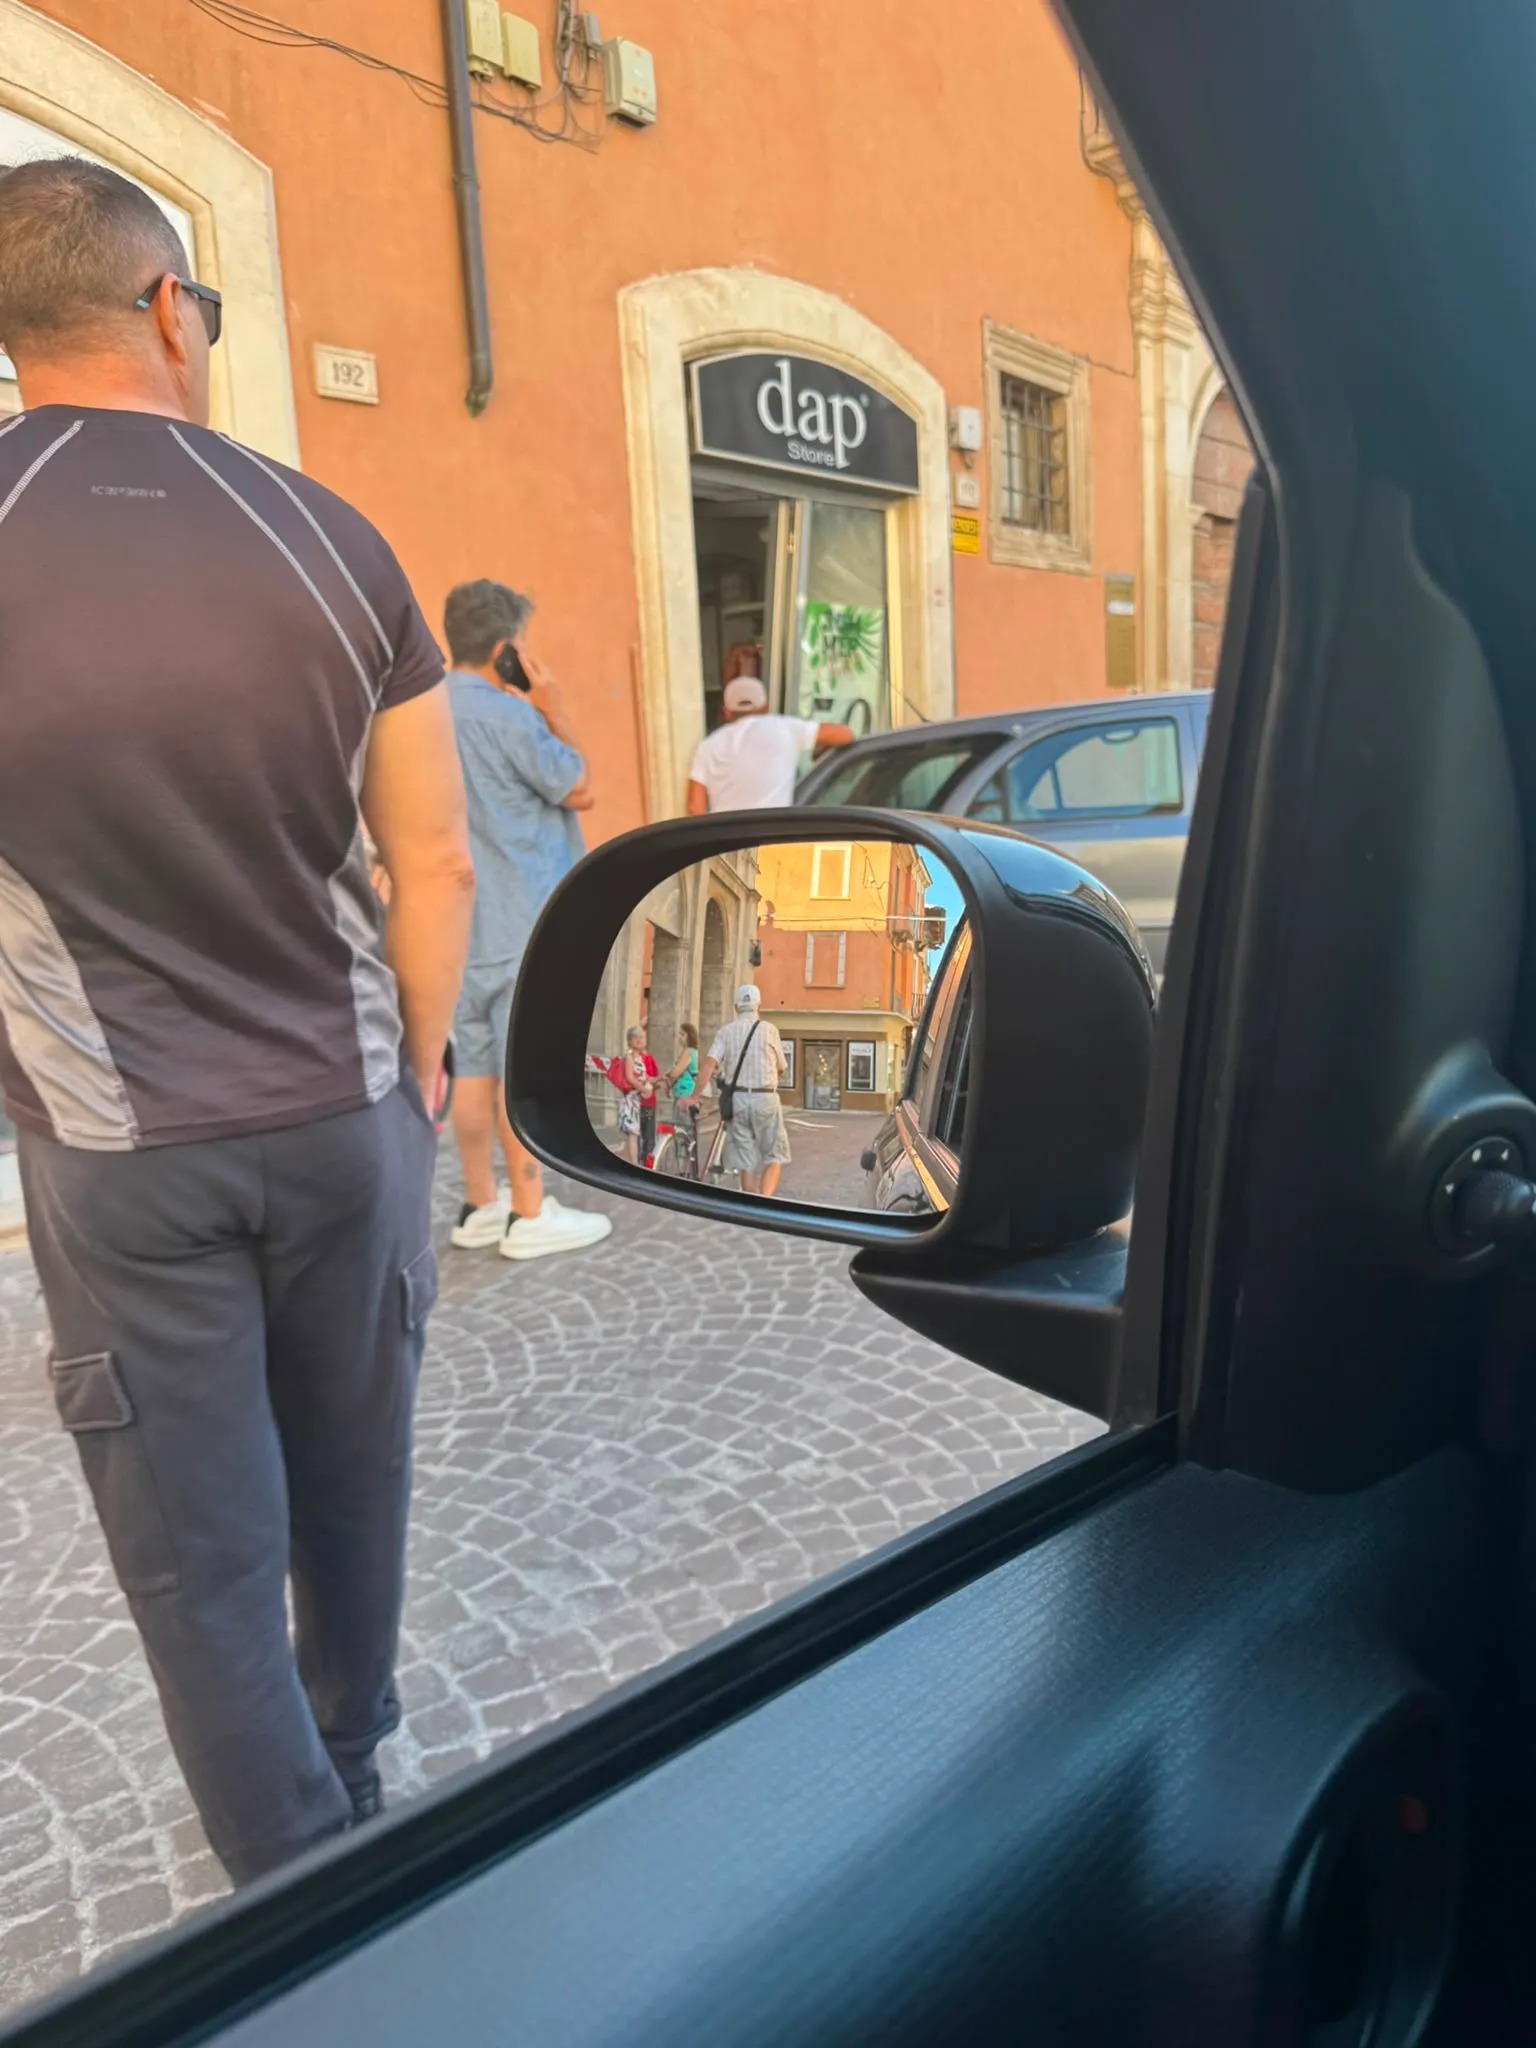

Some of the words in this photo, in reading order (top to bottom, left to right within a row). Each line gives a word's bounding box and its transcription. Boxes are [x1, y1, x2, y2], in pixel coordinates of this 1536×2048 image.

[332, 361, 365, 387] 192
[757, 358, 867, 469] dap
[787, 440, 836, 467] Store
